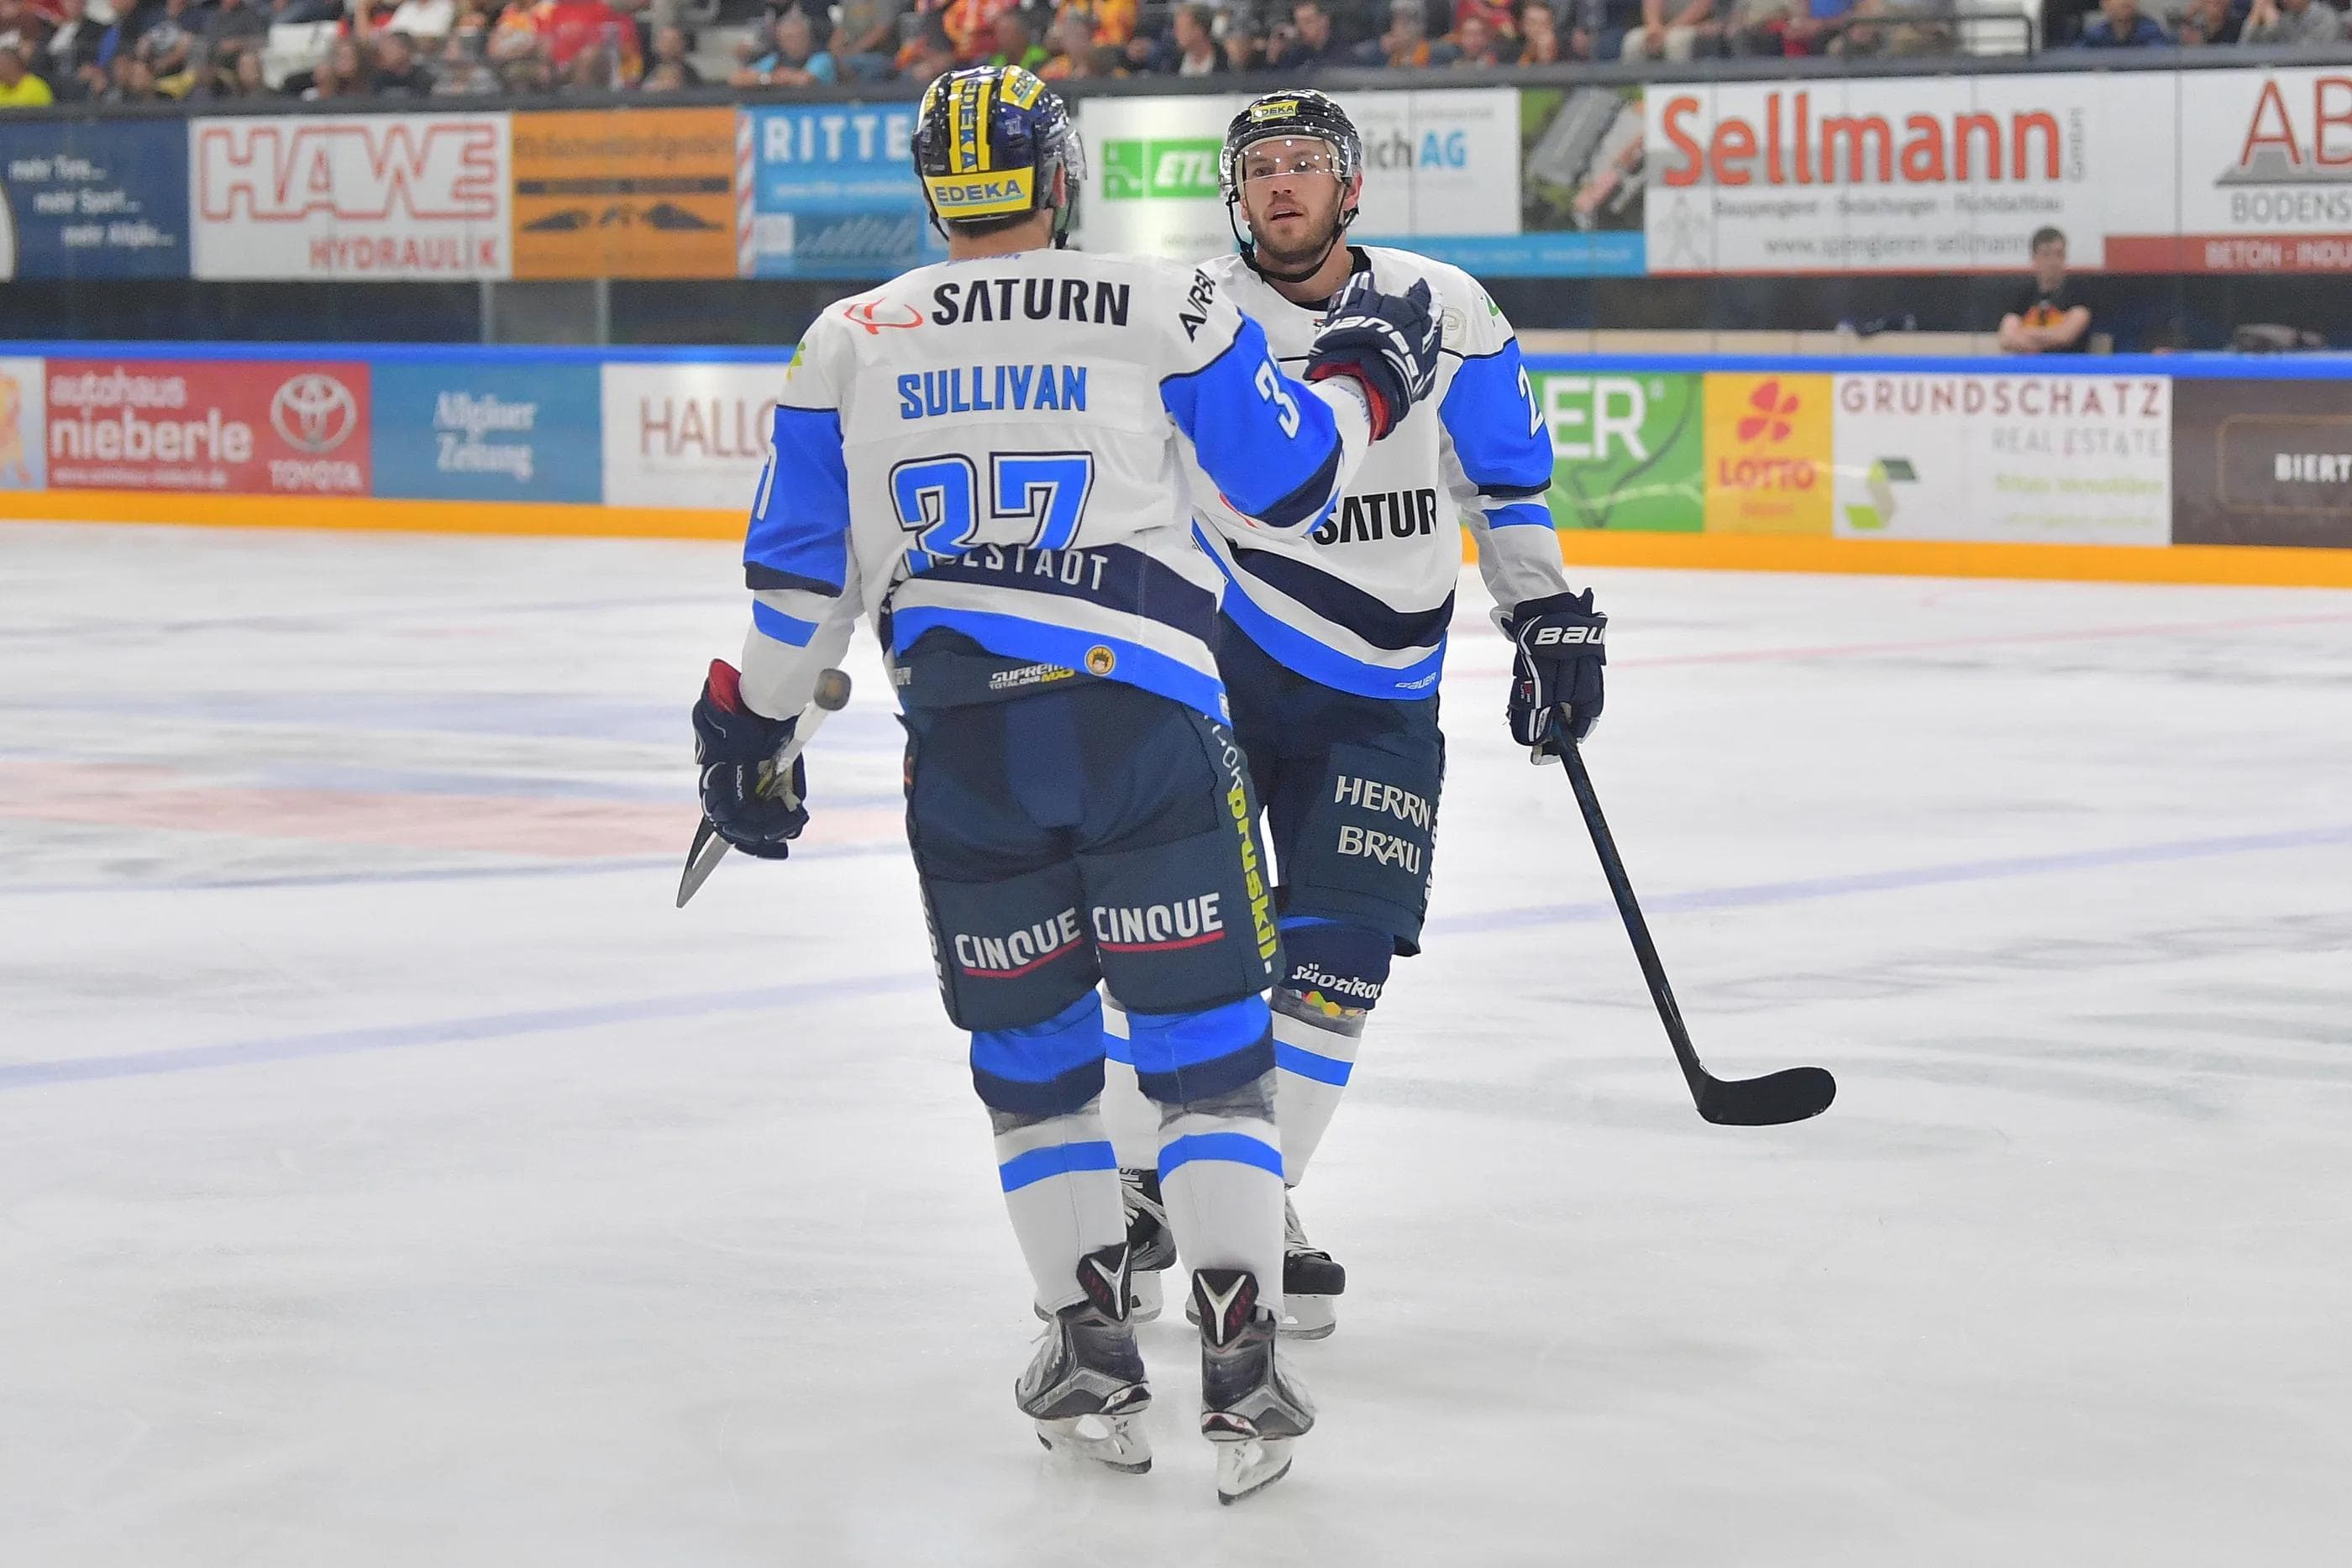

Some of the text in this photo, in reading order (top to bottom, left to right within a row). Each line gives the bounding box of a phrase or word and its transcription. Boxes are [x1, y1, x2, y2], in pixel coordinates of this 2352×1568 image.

[1255, 105, 1294, 117] DEKA
[763, 115, 911, 162] RITTE
[1420, 130, 1466, 168] AG
[1662, 93, 2061, 186] Sellmann
[201, 123, 499, 222] HAWE
[1154, 150, 1217, 187] ETL
[934, 180, 1022, 202] EDEKA
[311, 236, 499, 270] HYDRAULIK
[932, 278, 1131, 326] SATURN
[897, 364, 1088, 419] SULLIVAN
[1840, 380, 2161, 417] GRUNDSCHATZ
[51, 408, 252, 464] nieberle
[1991, 427, 2050, 454] REAL
[268, 460, 363, 490] TOYOTA
[1718, 457, 1817, 490] LOTTO
[2273, 453, 2352, 483] BIERT
[1534, 627, 1606, 645] BAU
[1334, 774, 1431, 831] HERRN
[1336, 825, 1421, 875] BRÄU
[1092, 892, 1223, 943] CINQUE
[955, 907, 1082, 970] CINQUE
